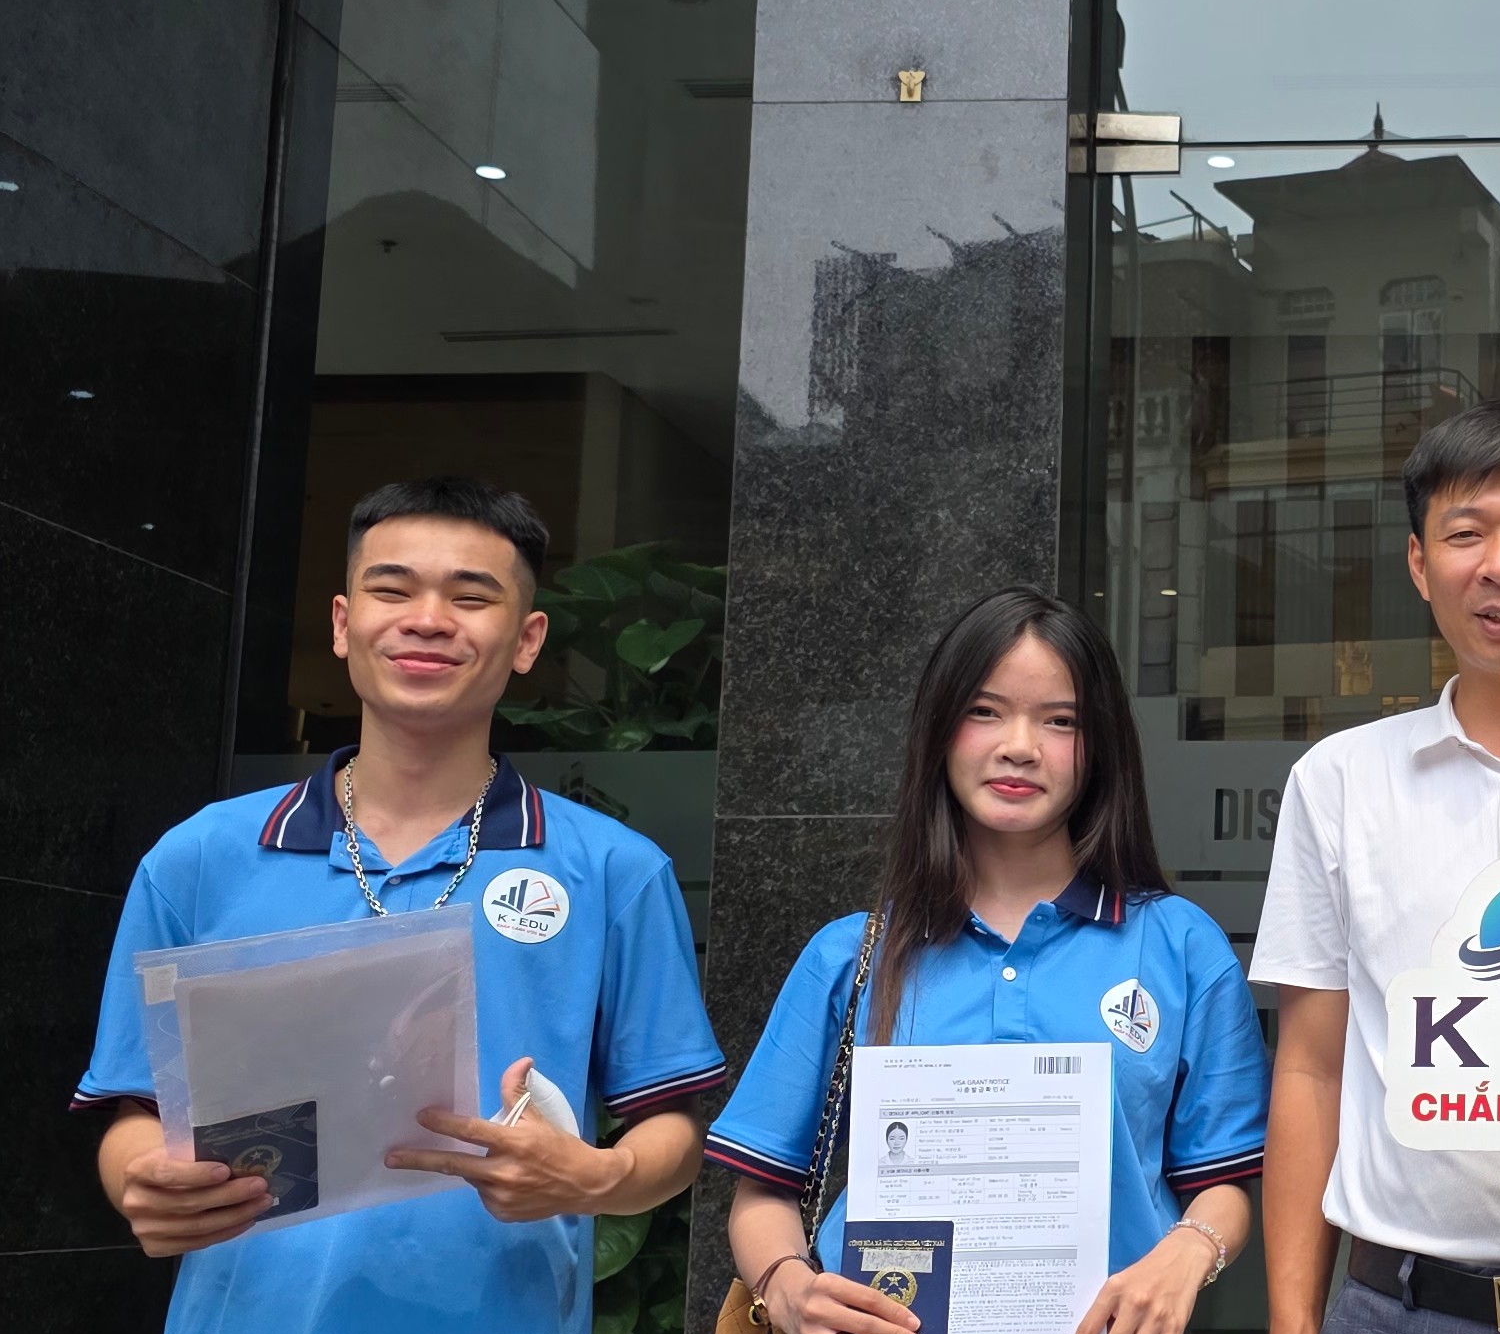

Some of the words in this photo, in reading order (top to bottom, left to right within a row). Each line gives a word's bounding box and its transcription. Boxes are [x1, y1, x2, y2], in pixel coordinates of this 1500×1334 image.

[497, 913, 508, 923] K
[519, 917, 548, 931] EDU
[1411, 996, 1489, 1068] K
[967, 1078, 987, 1086] GRANT
